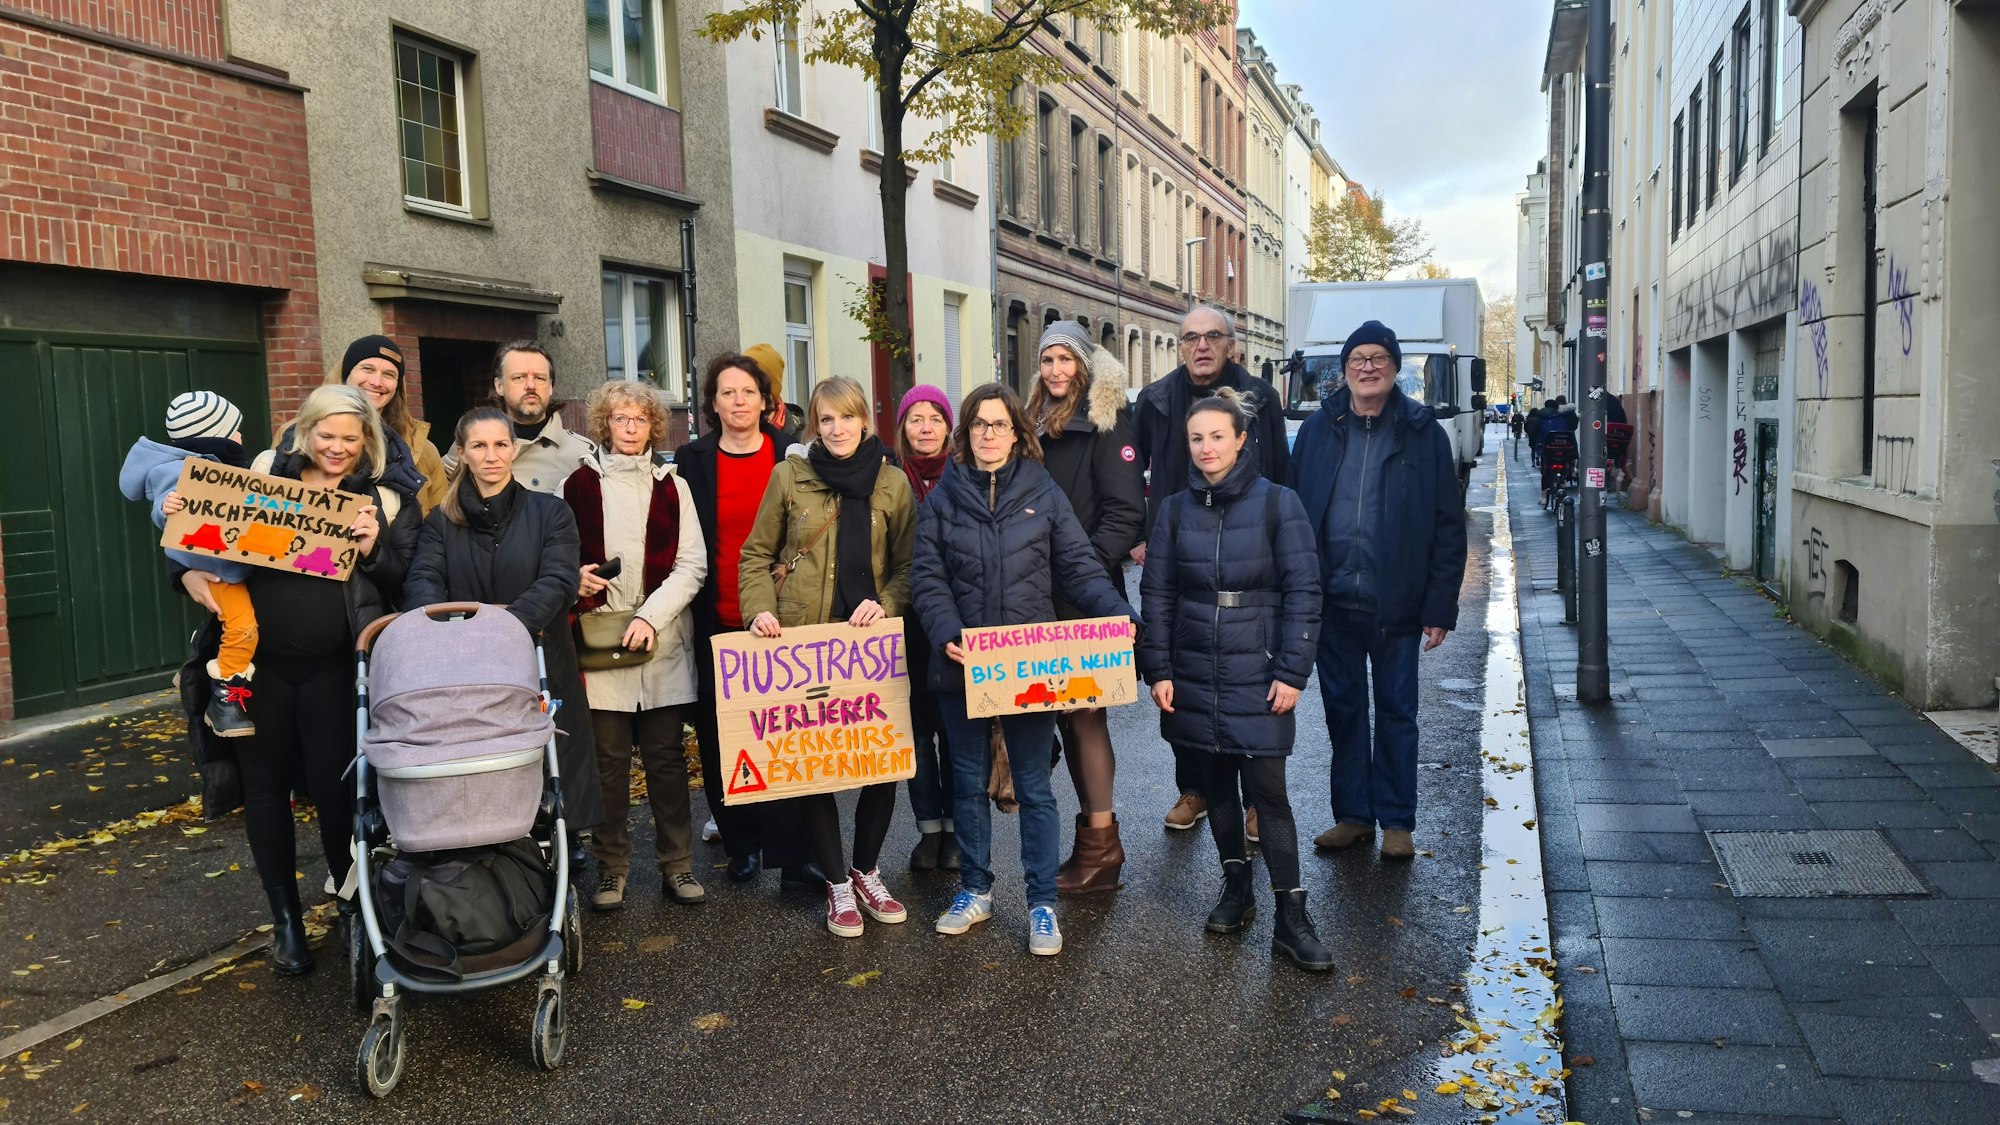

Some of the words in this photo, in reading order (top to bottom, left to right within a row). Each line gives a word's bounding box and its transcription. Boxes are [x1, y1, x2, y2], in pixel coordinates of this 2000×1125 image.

[190, 464, 353, 513] WOHNQUALITÄT
[244, 492, 304, 514] STATT
[180, 496, 361, 543] DURCHFAHRTSSTRA
[719, 632, 907, 700] PIUSSTRASSE
[971, 662, 1007, 685] BIS
[1017, 656, 1074, 679] EINER
[1080, 650, 1133, 671] WEINT
[749, 692, 888, 741] VERLIERER
[766, 724, 905, 759] VERKEHRS-
[767, 747, 914, 784] EXPERIMENT
